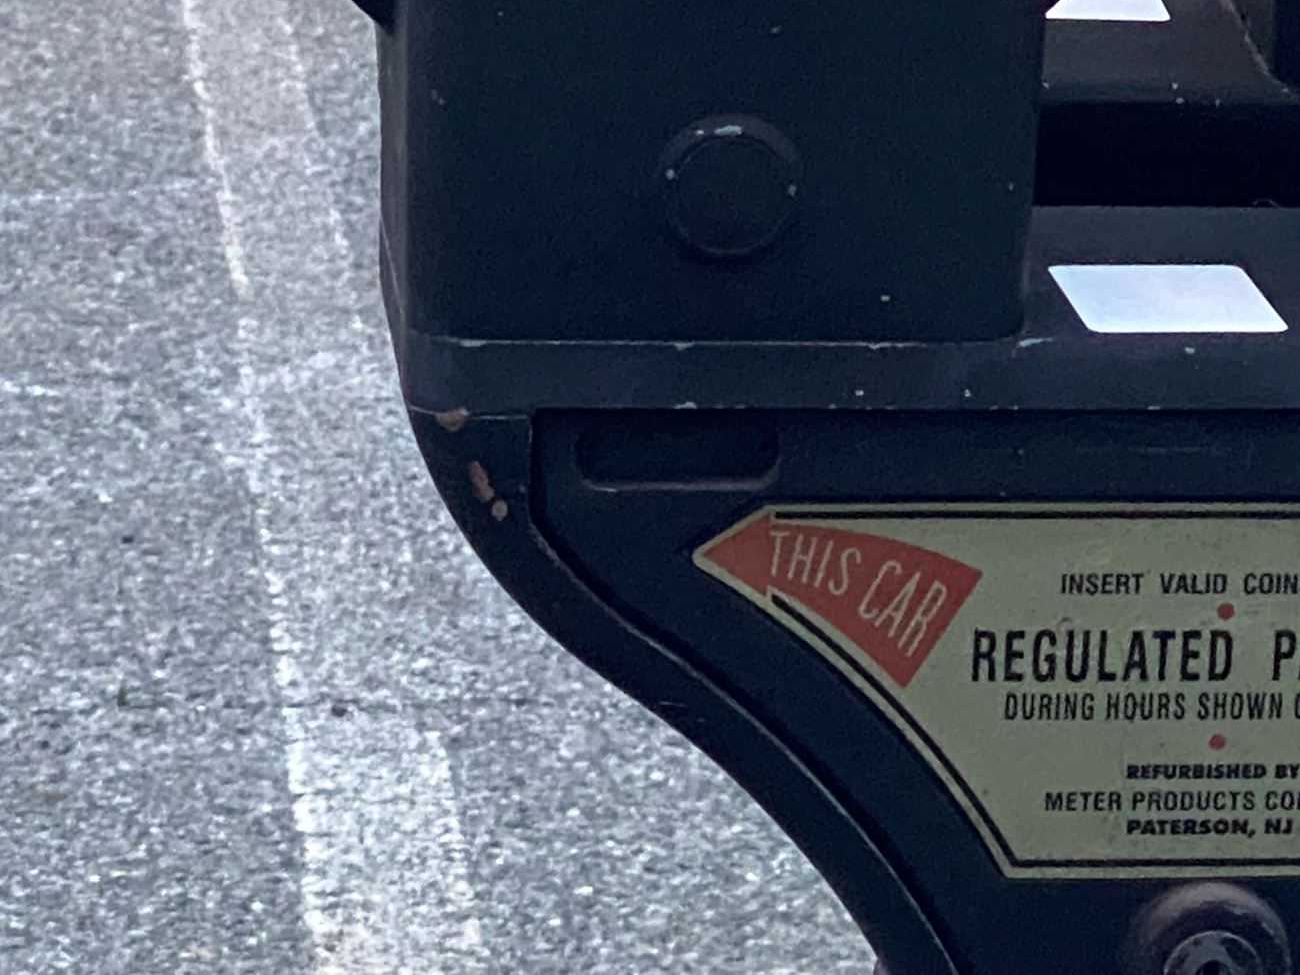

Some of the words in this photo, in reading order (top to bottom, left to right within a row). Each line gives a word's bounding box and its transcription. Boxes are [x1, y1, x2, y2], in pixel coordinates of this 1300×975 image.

[1060, 573, 1145, 594] INSERT
[1159, 573, 1227, 594] VALID
[769, 531, 862, 596] THIS
[857, 560, 948, 658] CAR
[971, 629, 1233, 683] REGULATED
[1003, 693, 1095, 721] DURING
[1105, 693, 1186, 721] HOURS
[1196, 693, 1283, 720] SHOWN
[1126, 764, 1267, 780] REFURBISHED
[1273, 764, 1300, 779] BY
[1044, 791, 1122, 812] METER
[1131, 791, 1255, 811] PRODUCTS
[1126, 819, 1255, 838] PATERSON,
[1264, 819, 1294, 835] NJ
